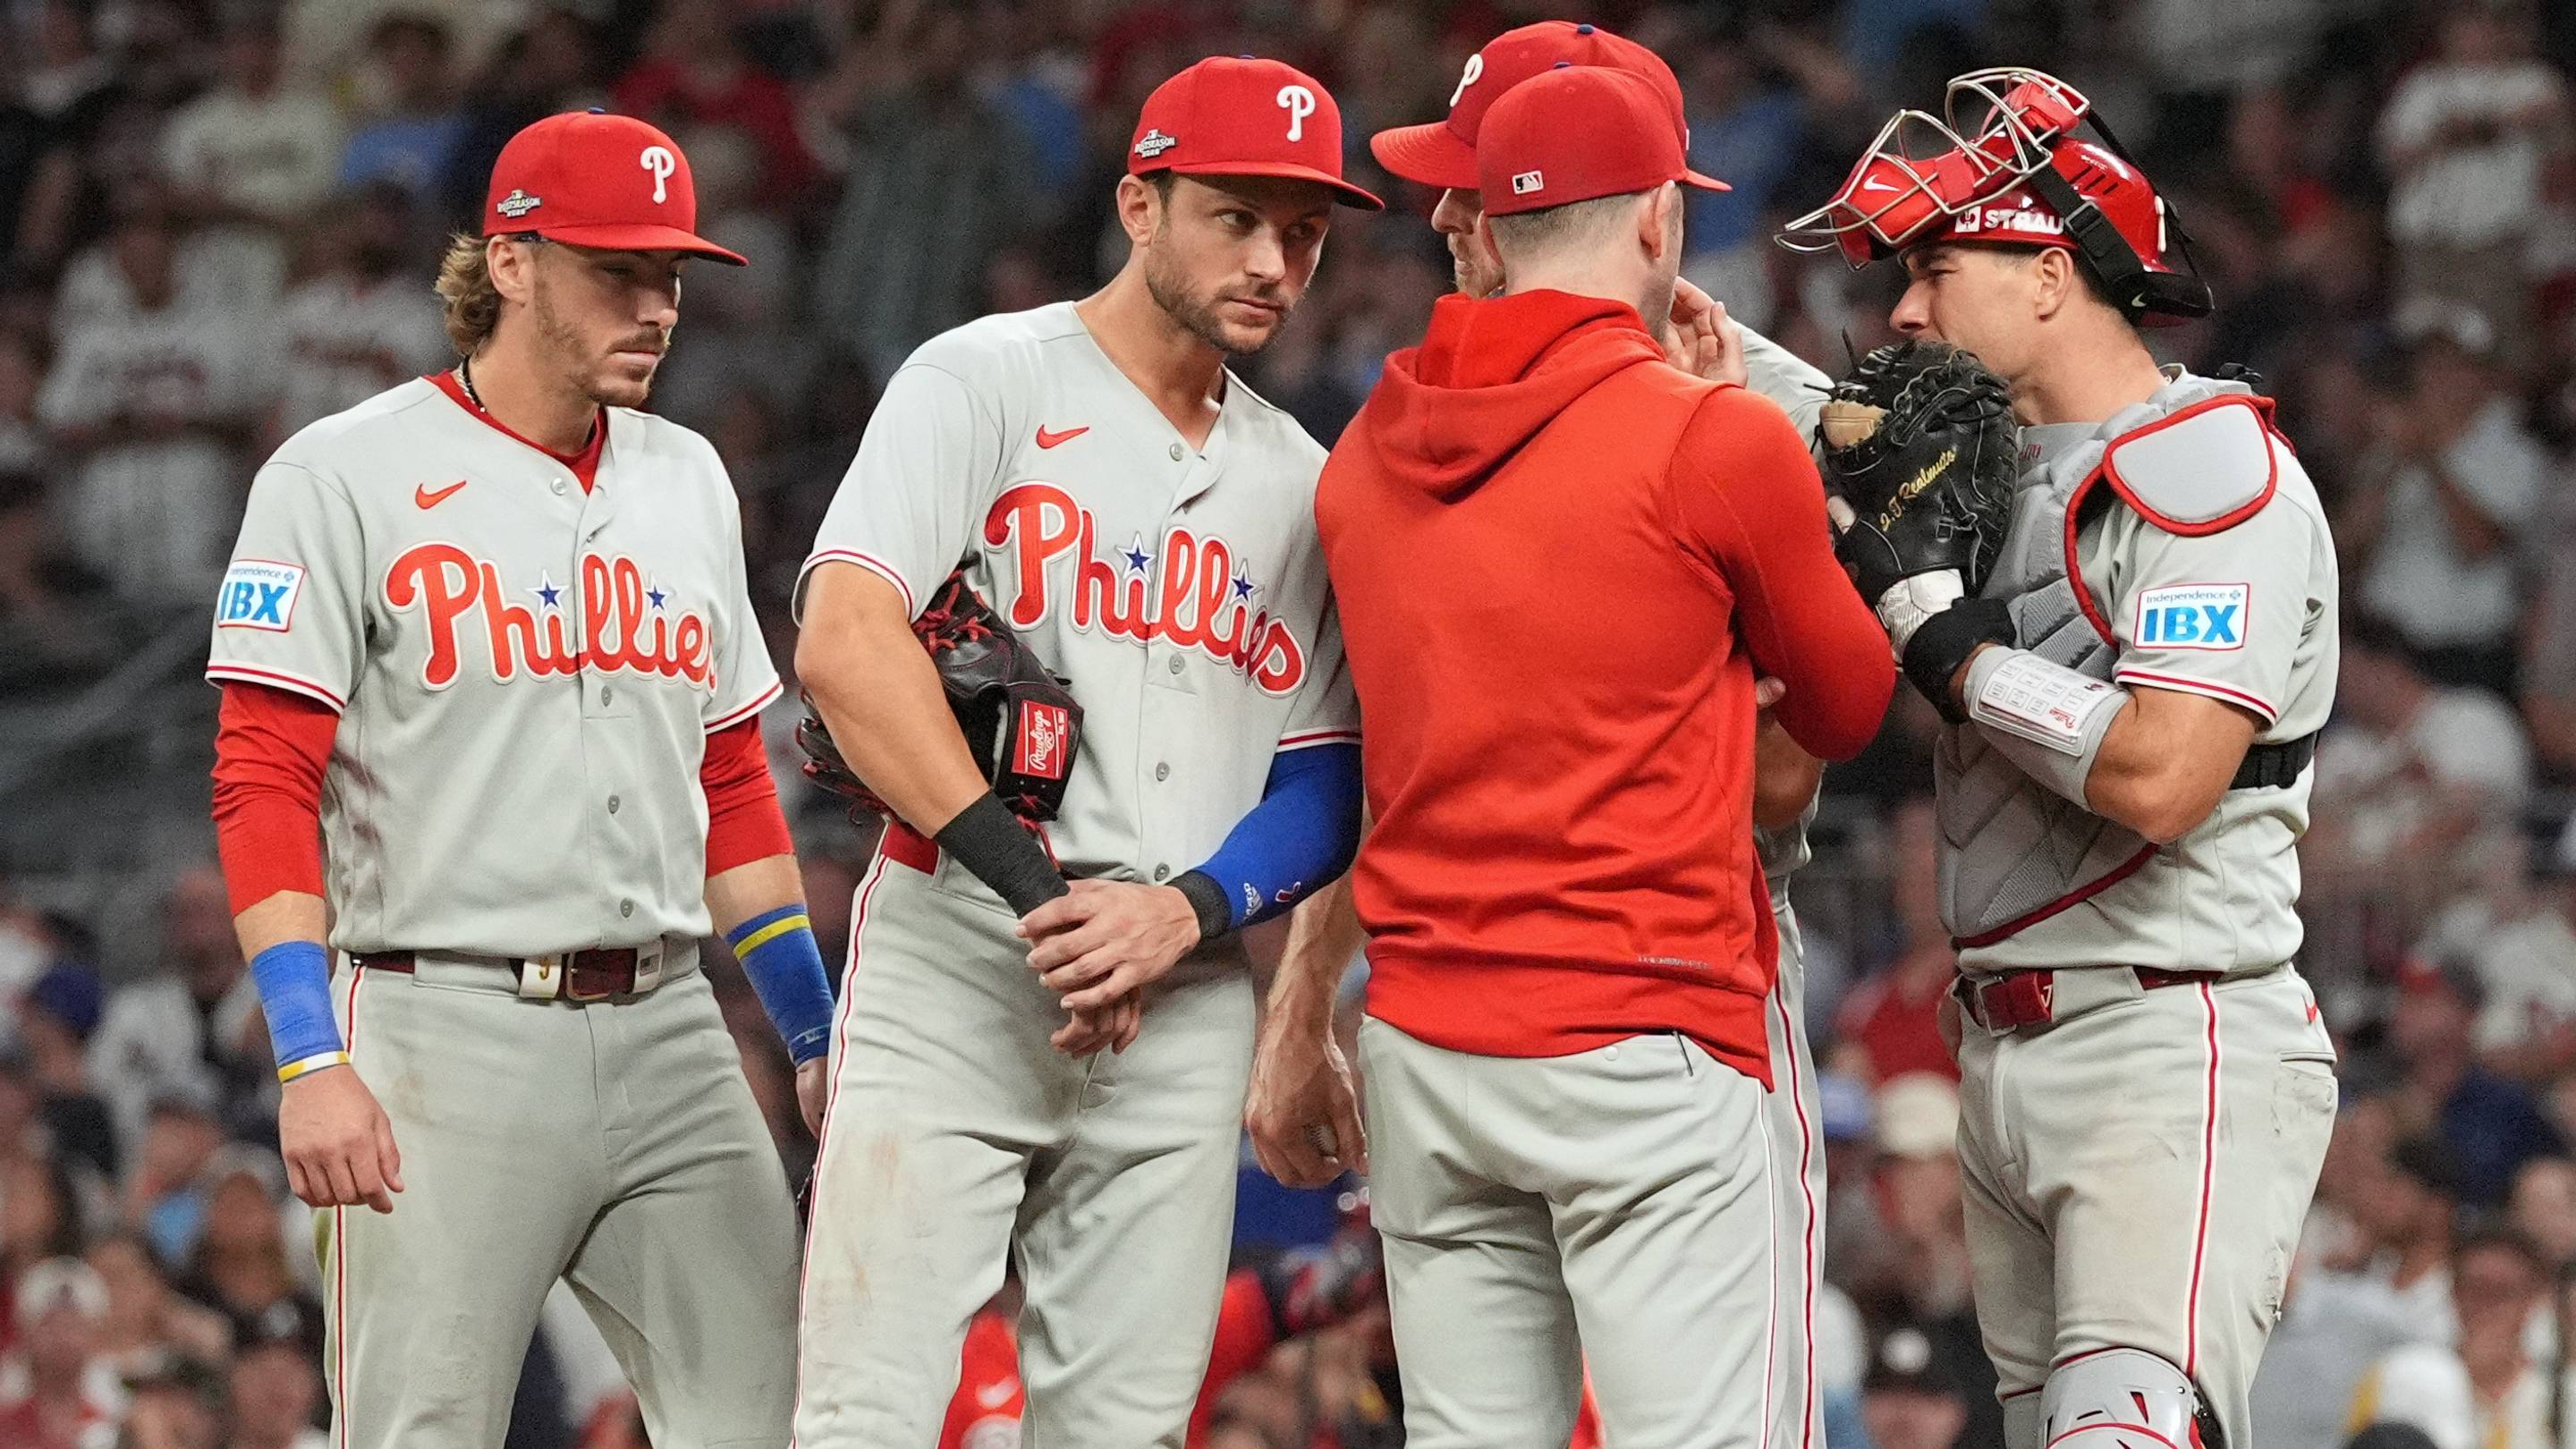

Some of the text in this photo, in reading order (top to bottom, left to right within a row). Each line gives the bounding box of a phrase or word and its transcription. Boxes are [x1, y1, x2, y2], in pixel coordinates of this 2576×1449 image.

[1450, 54, 1484, 107] P
[1276, 84, 1316, 142] P
[640, 146, 675, 204] P
[219, 581, 289, 624] IBX
[383, 540, 717, 692] Phillie
[2143, 605, 2239, 643] IBX
[2146, 590, 2226, 604] Independence
[1030, 709, 1052, 770] Rawlings
